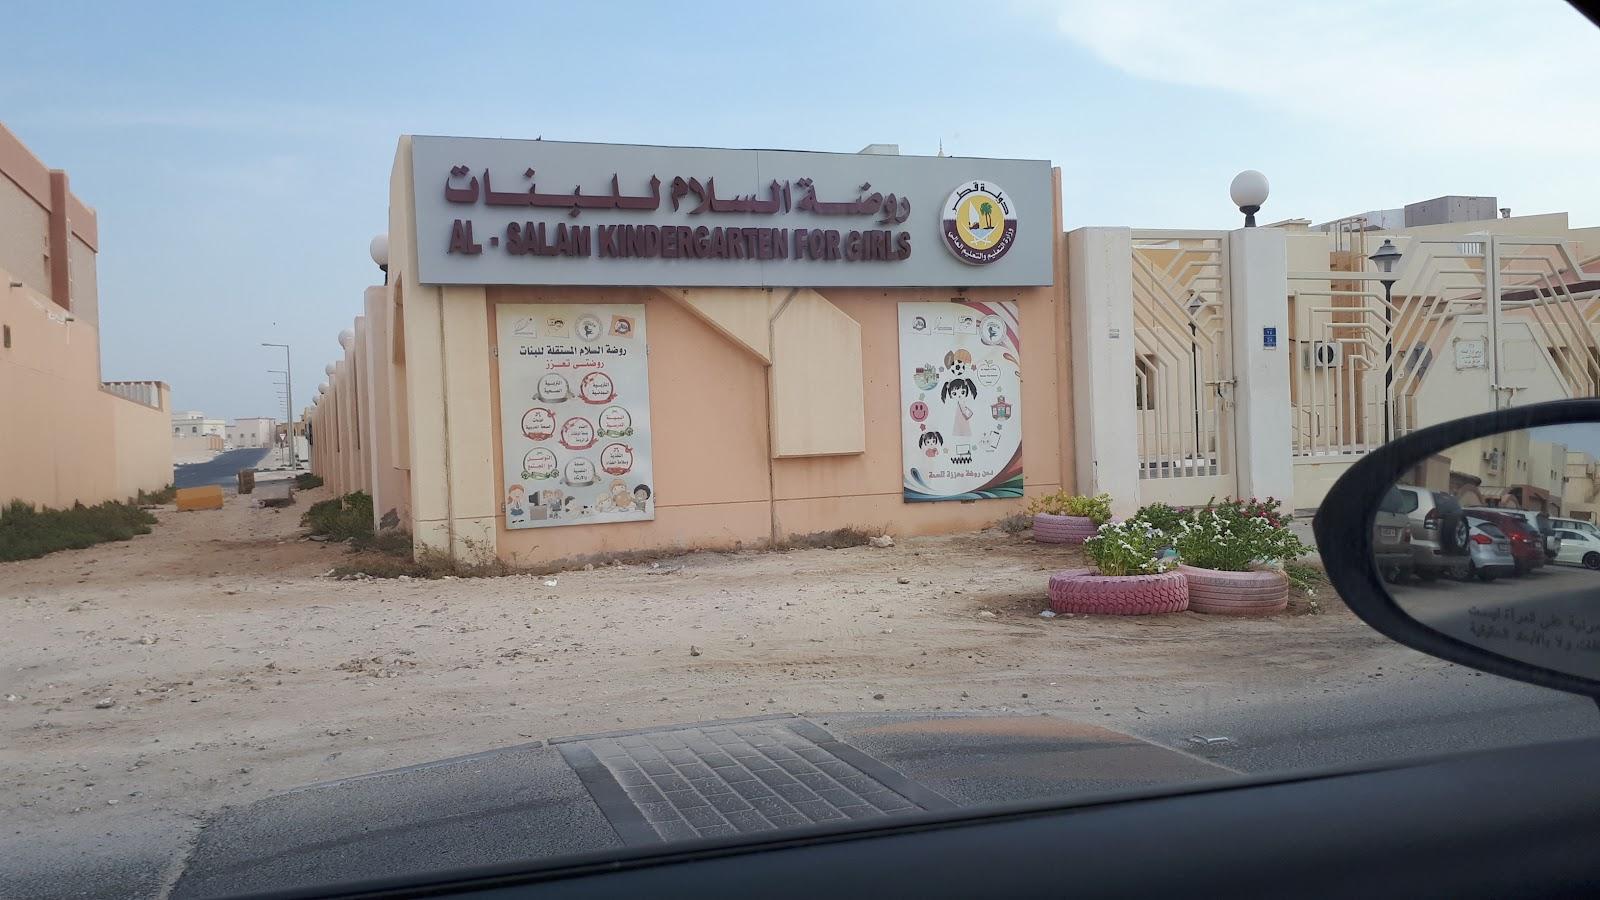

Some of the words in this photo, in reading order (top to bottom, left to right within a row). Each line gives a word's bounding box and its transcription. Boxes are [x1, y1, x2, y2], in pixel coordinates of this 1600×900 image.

[445, 164, 661, 218] للبنات
[671, 175, 792, 215] السلام
[796, 176, 911, 225] روضة
[951, 181, 979, 214] قطر
[980, 183, 1009, 216] دولة
[449, 219, 483, 254] AL
[506, 221, 592, 257] SALAM
[598, 224, 789, 261] KINDERGARTEN
[795, 228, 842, 261] FOR
[846, 229, 912, 262] GIRLS
[519, 345, 544, 358] للبنات
[546, 345, 577, 355] المستقلة
[580, 345, 604, 356] السلام
[605, 344, 627, 356] روضة
